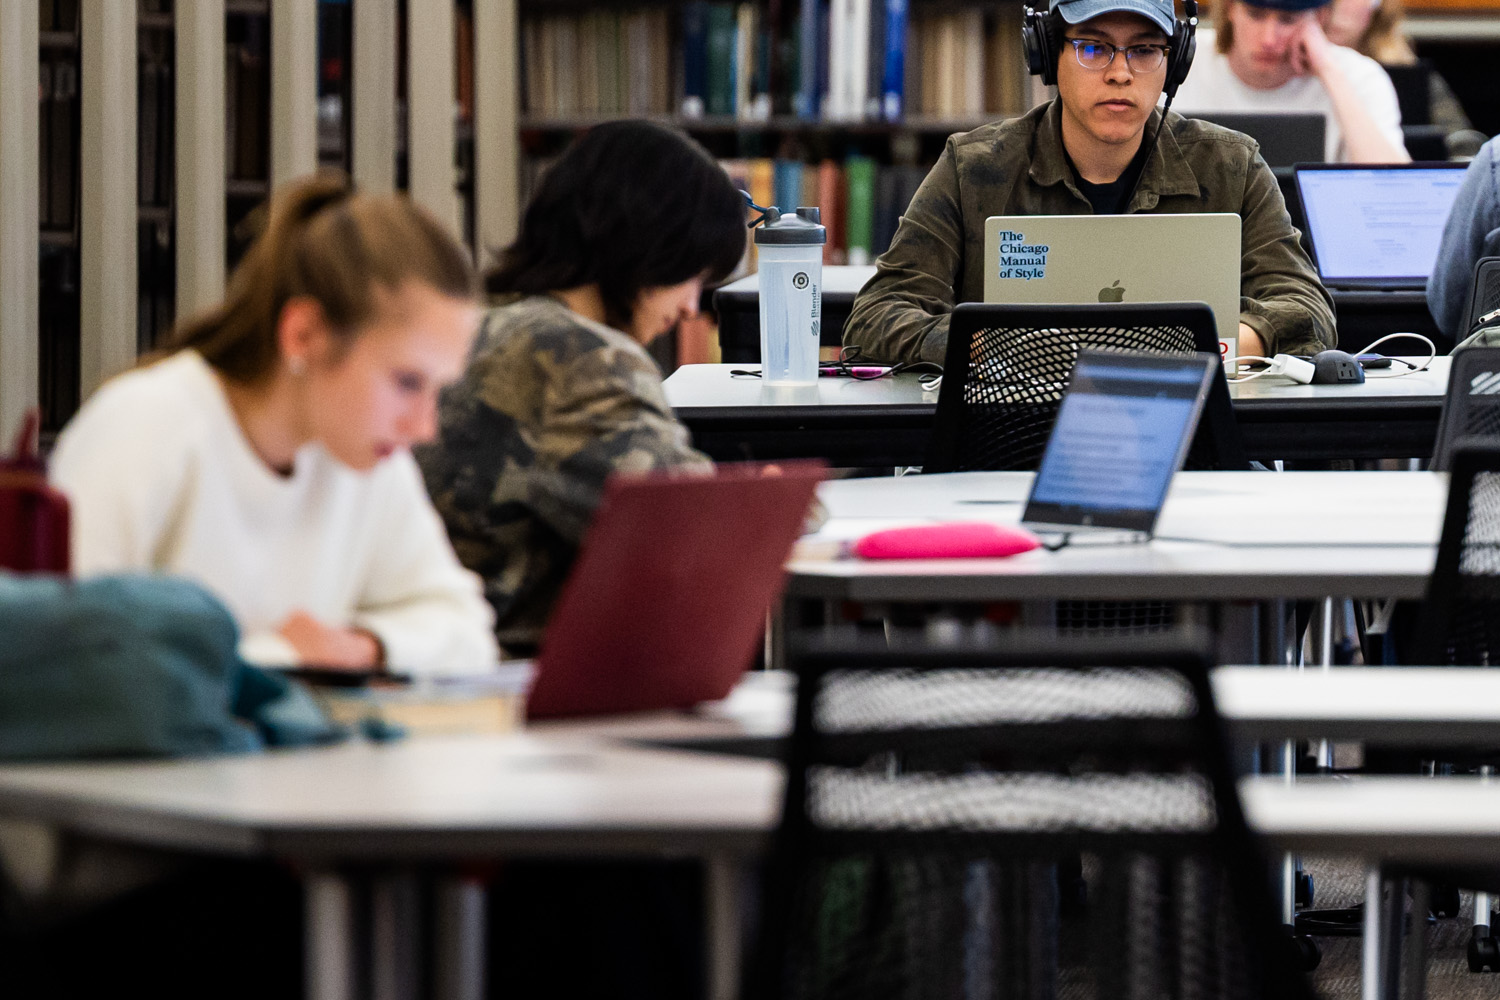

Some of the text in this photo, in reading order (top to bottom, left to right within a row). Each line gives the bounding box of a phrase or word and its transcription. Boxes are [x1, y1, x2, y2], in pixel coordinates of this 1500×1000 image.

[1000, 231, 1023, 241] The
[1000, 243, 1049, 255] Chicago
[1000, 255, 1046, 266] Manual
[1000, 268, 1044, 280] of Style
